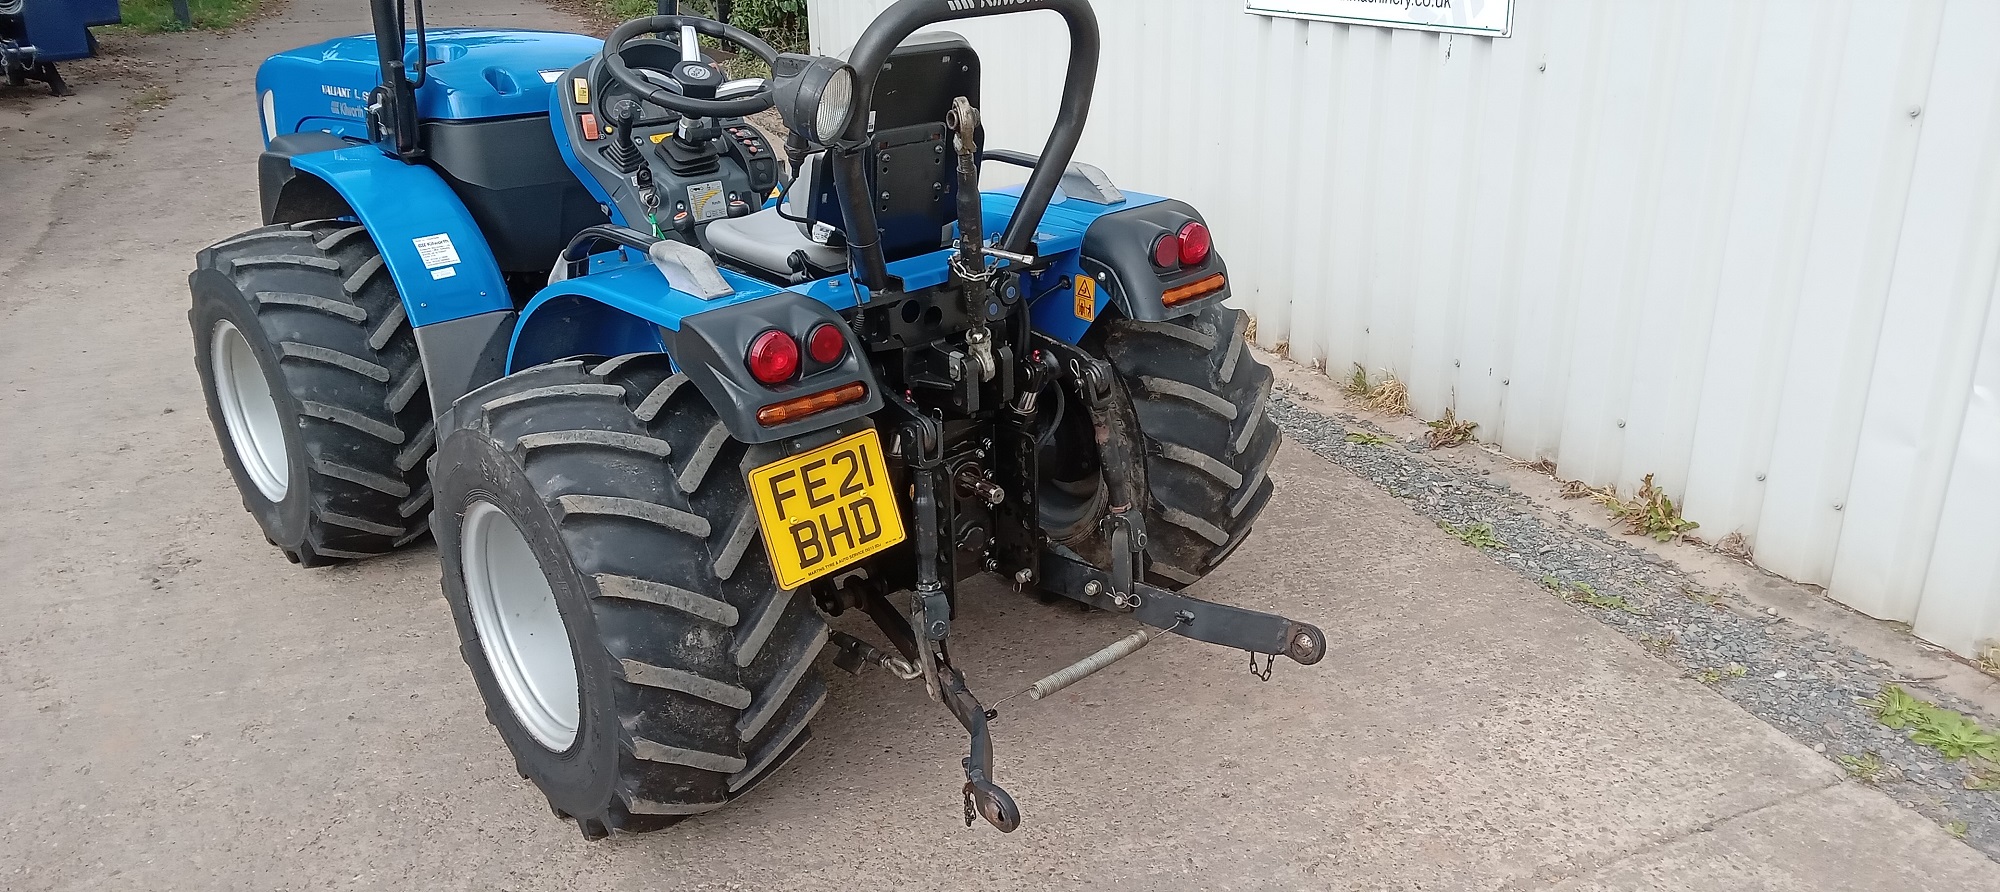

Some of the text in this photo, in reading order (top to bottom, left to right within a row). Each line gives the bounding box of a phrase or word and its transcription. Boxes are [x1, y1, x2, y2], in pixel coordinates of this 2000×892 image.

[321, 84, 351, 98] VALIANT
[768, 444, 875, 522] FE21
[788, 496, 882, 570] BHD
[839, 556, 849, 564] AUTO
